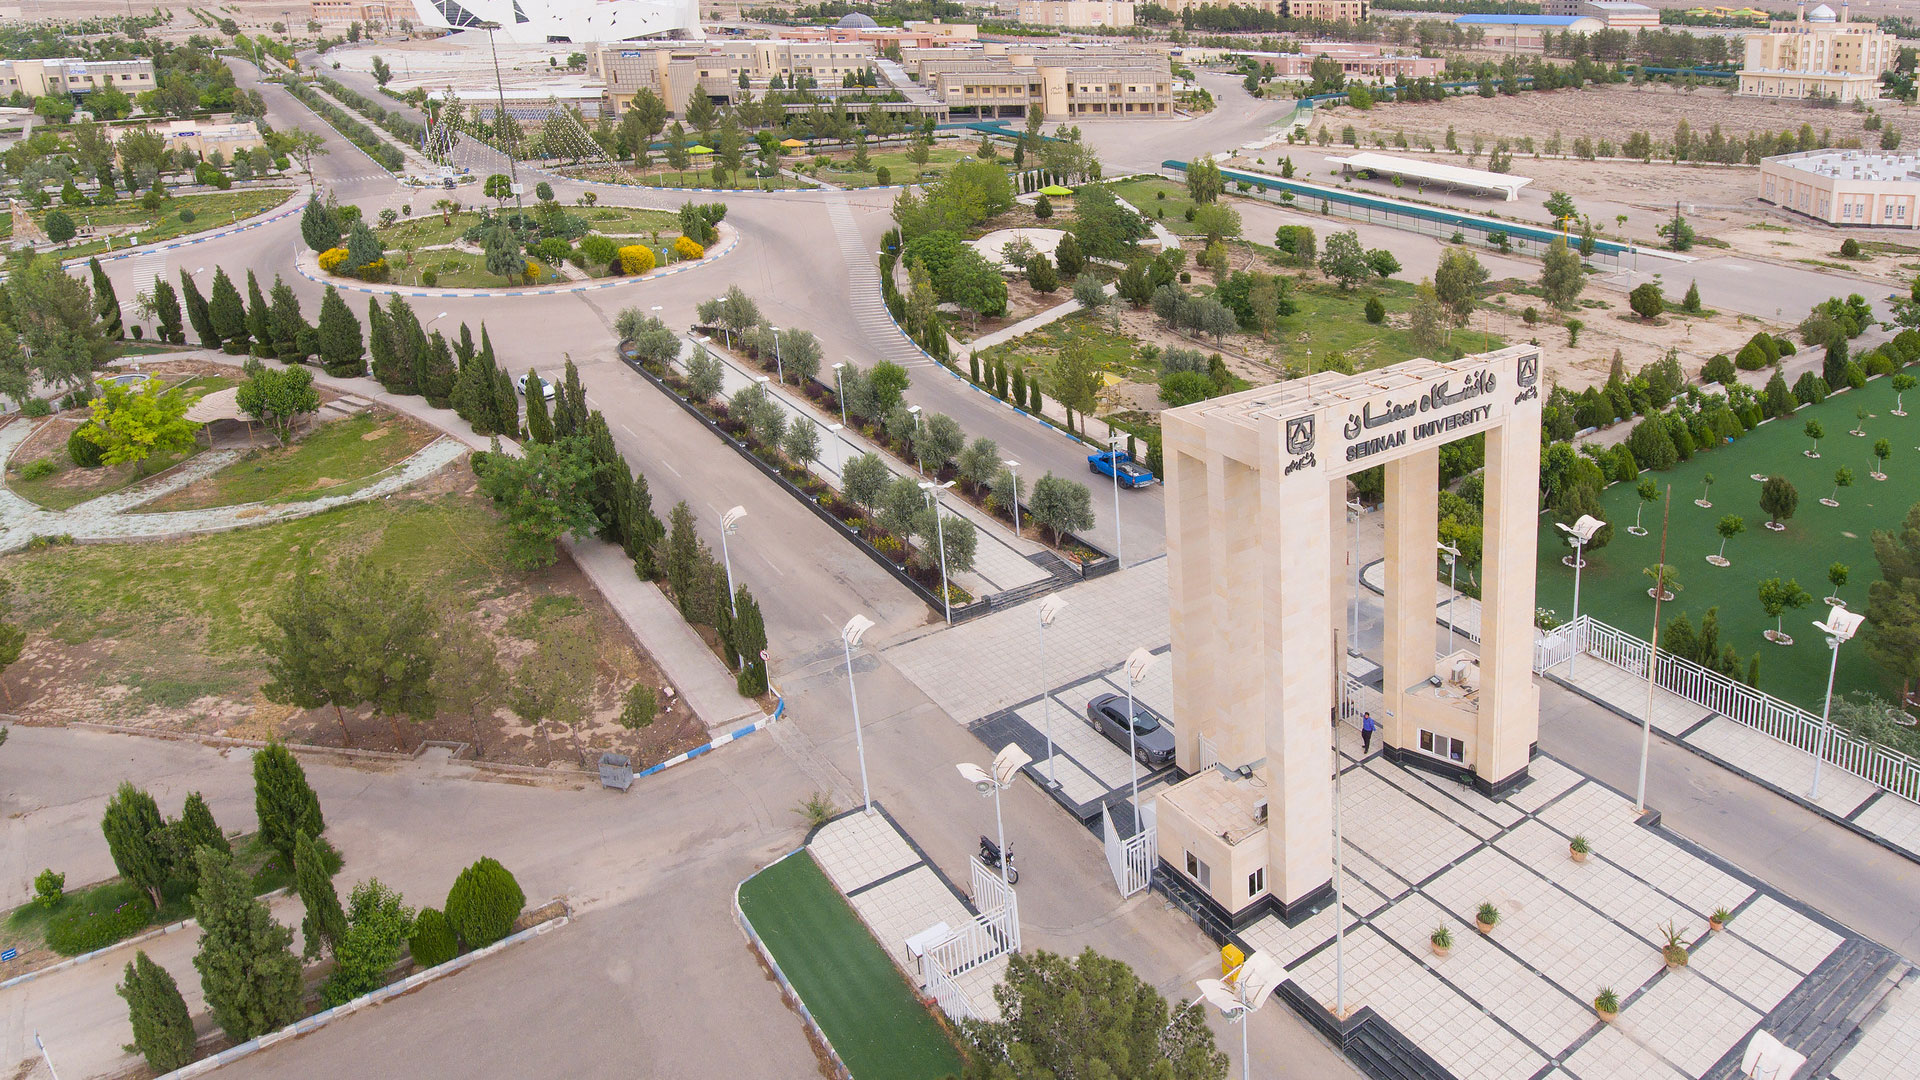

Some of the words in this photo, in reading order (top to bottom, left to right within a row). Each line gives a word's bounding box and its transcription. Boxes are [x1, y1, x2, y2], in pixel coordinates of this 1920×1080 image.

[1420, 369, 1497, 412] دانشگاه
[1344, 400, 1417, 440] سمنان
[1346, 430, 1406, 462] SEMNAN
[1413, 403, 1492, 441] UNIVERSITY
